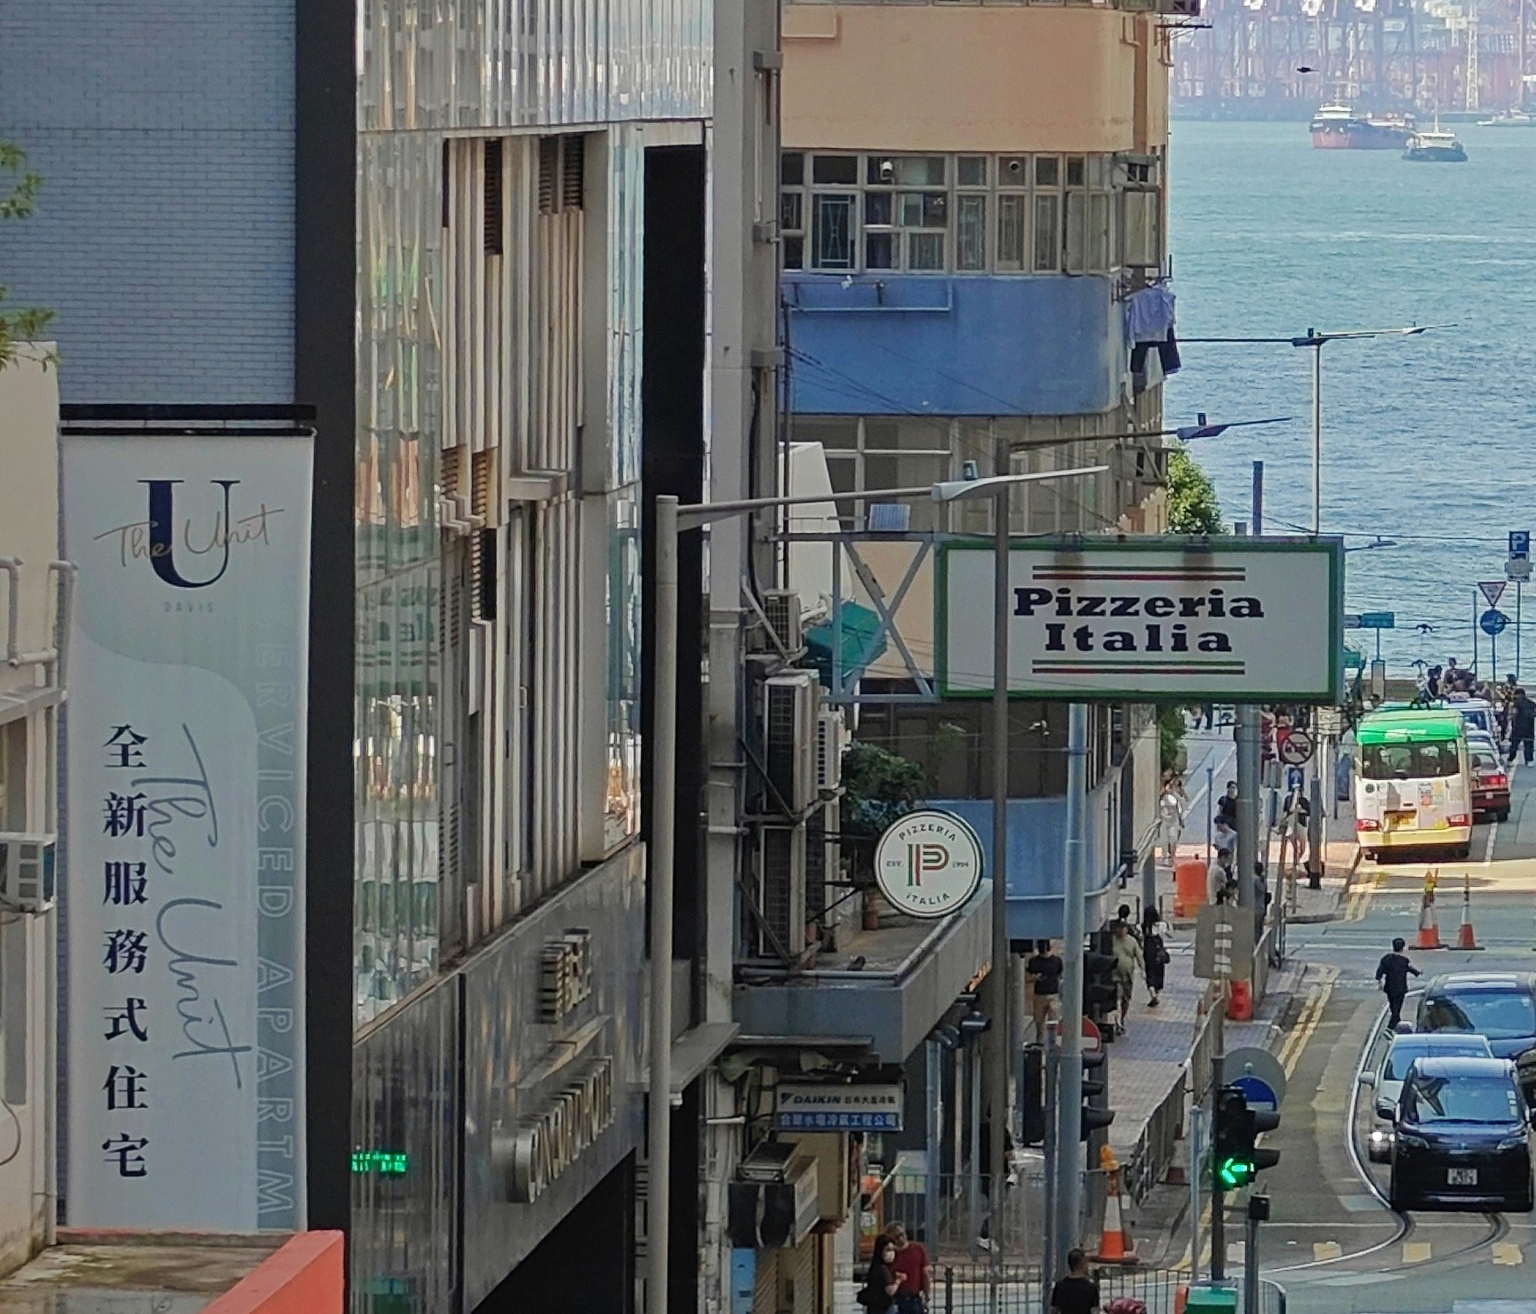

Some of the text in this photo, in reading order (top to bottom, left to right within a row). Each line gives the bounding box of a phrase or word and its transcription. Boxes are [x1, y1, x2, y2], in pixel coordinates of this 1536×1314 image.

[94, 503, 286, 567] The Unit
[137, 479, 241, 588] U
[163, 601, 214, 613] DAVIS
[1013, 587, 1265, 618] Pizzeria
[1045, 623, 1232, 652] Italia
[899, 823, 957, 841] PIZZERIA
[131, 723, 252, 1089] The Unit
[906, 892, 951, 905] ITALIA
[102, 723, 149, 1178] 全新服務式住宅
[256, 956, 294, 1231] APARTM
[793, 1095, 841, 1104] DAIKIN
